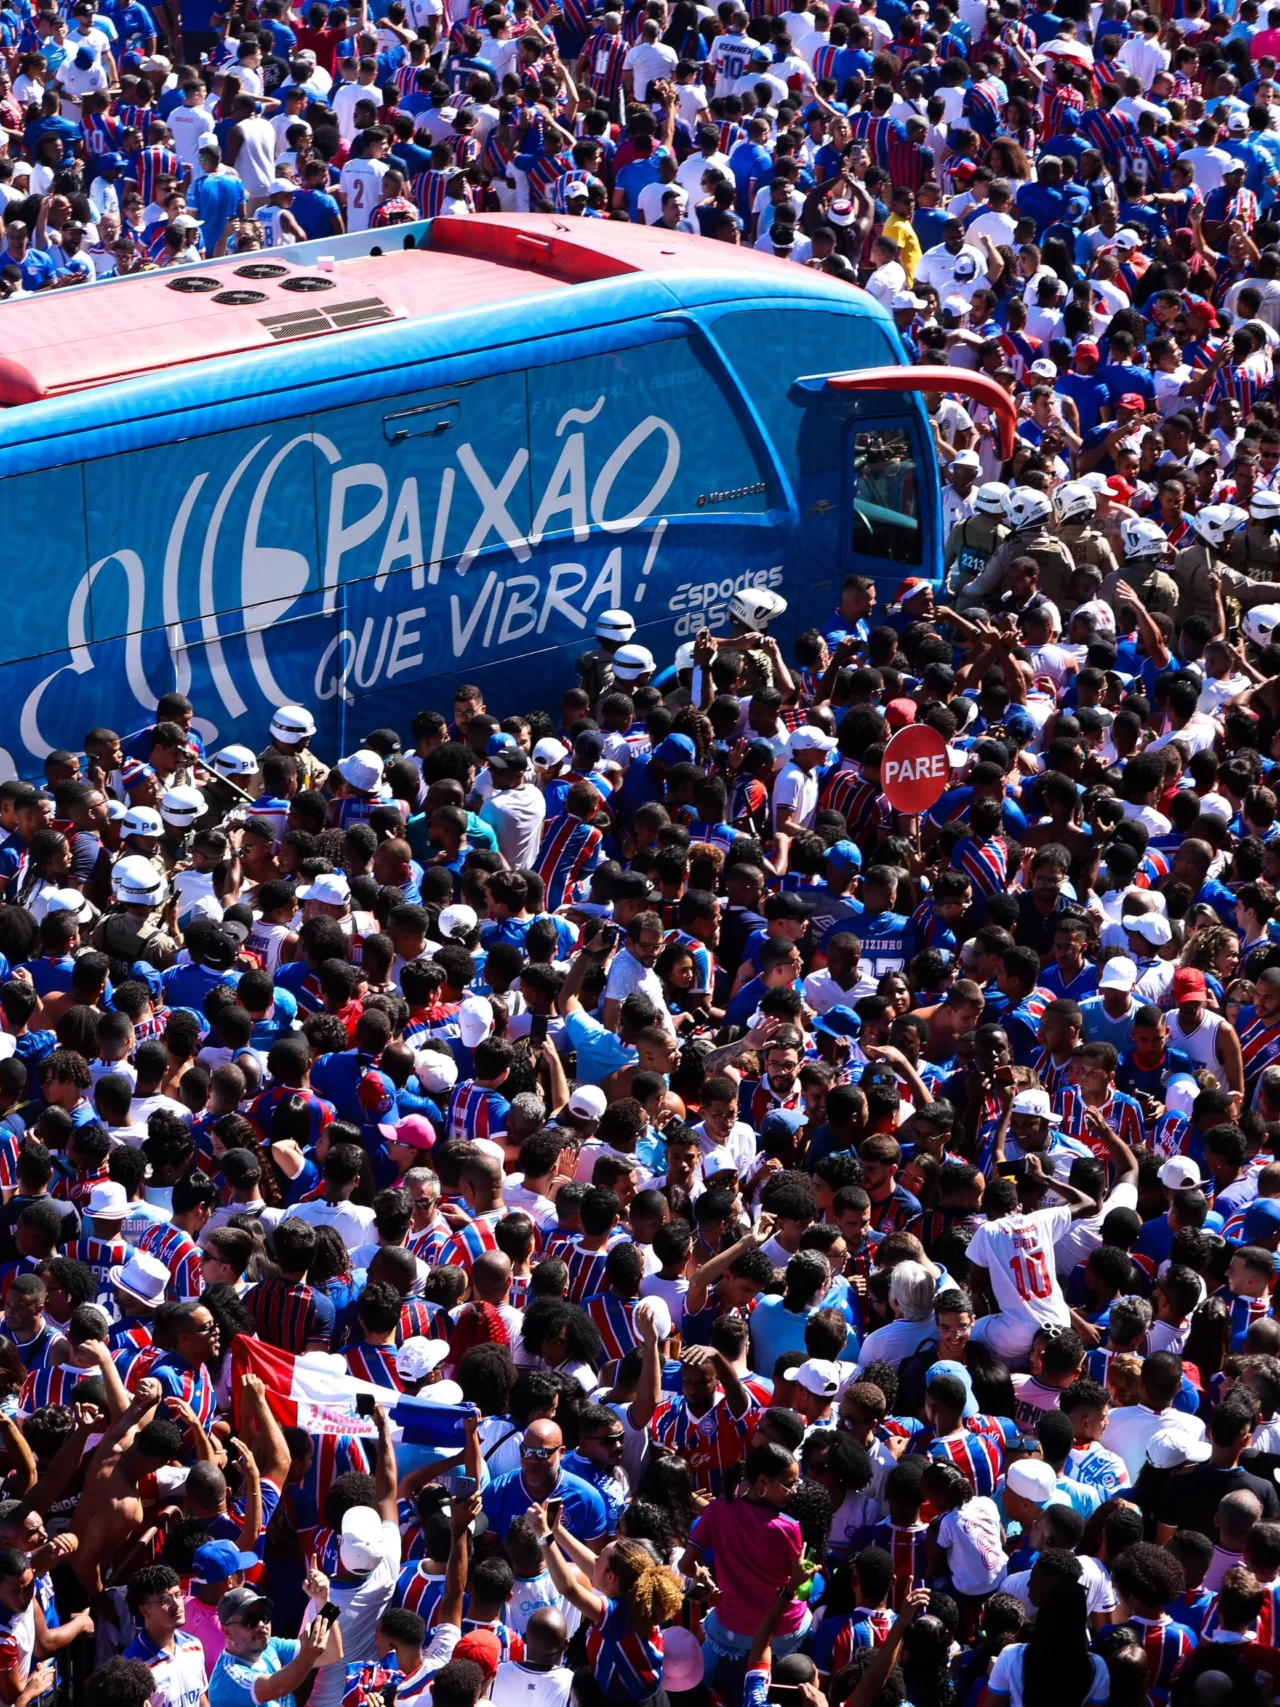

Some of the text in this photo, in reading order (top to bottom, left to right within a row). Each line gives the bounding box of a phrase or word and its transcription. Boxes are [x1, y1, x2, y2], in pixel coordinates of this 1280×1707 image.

[723, 55, 744, 78] 10
[352, 178, 365, 209] 2
[323, 396, 681, 617] PAIXÃO
[961, 553, 985, 573] 2213
[1248, 567, 1273, 583] 2213
[668, 565, 784, 612] Esportes
[314, 519, 668, 701] QUE VIBRA!
[885, 755, 945, 784] PARE
[1009, 1251, 1052, 1302] 10
